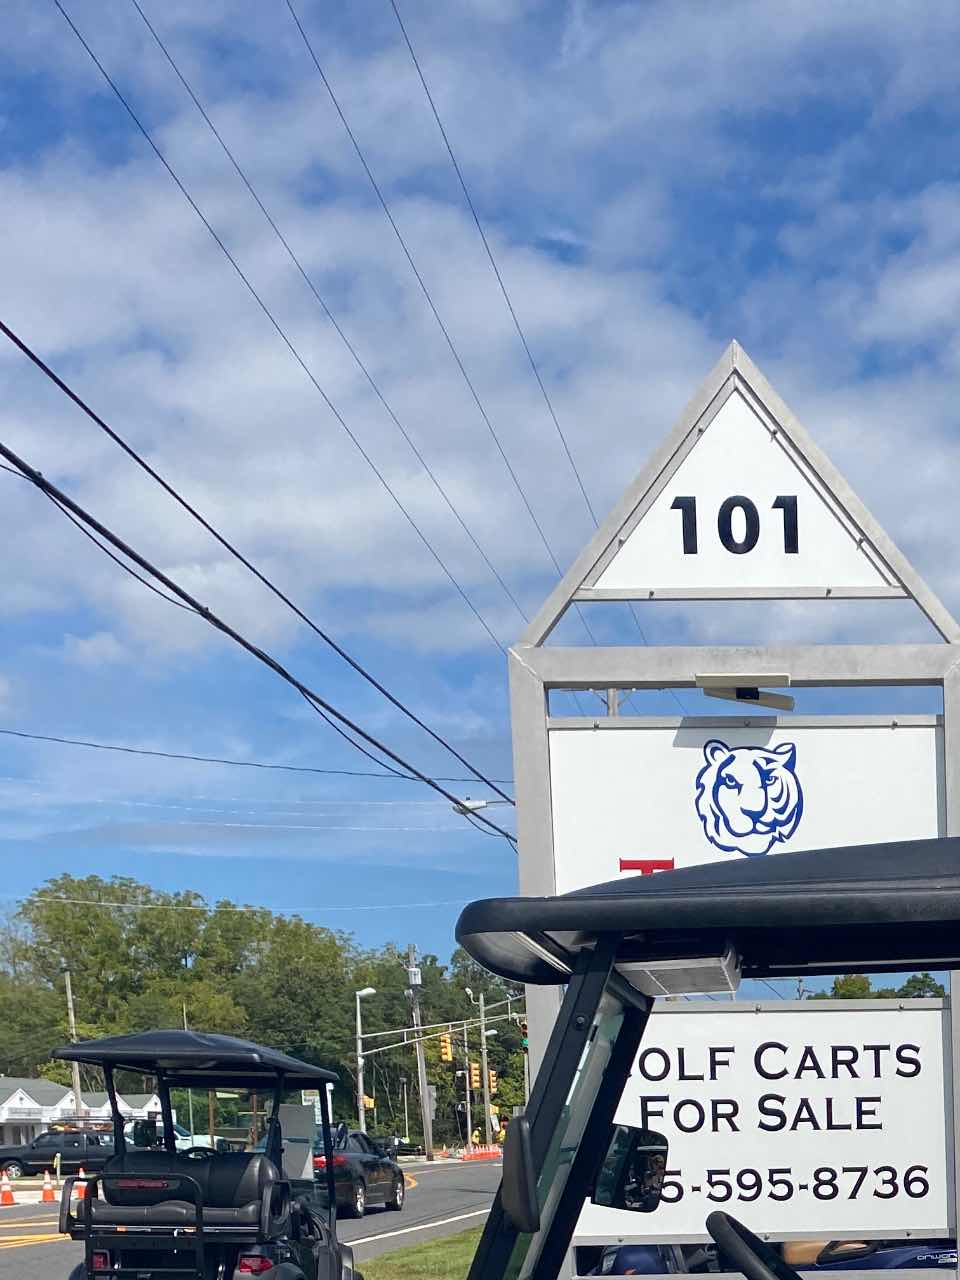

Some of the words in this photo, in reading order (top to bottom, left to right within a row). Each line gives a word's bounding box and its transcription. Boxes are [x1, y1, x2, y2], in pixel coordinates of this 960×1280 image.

[670, 495, 799, 555] 101
[627, 1046, 736, 1082] OLF
[753, 1041, 922, 1080] CARTS
[639, 1094, 741, 1133] FOR
[757, 1093, 883, 1132] SALE
[660, 1164, 930, 1204] 5-595-8736
